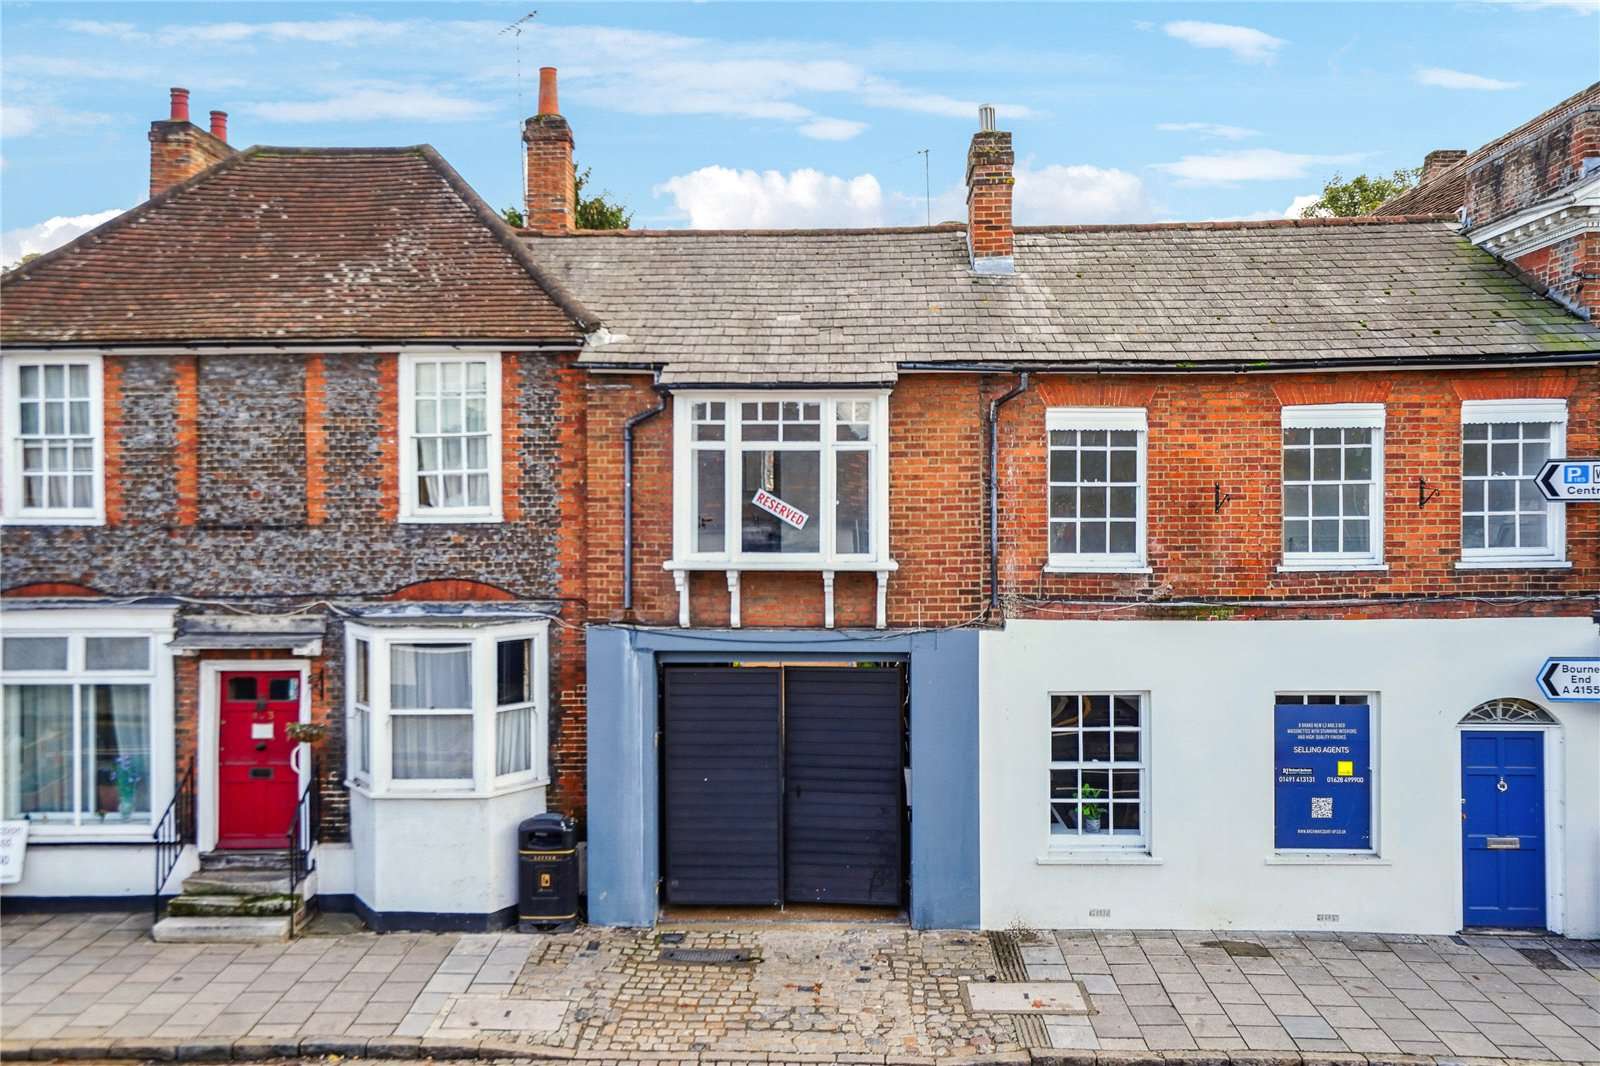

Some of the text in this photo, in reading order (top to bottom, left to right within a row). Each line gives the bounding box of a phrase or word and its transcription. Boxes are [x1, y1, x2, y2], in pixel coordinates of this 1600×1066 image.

[756, 492, 805, 525] RESERVED
[1562, 664, 1600, 673] Bourne
[1571, 675, 1591, 684] End
[1563, 686, 1600, 694] A 4155
